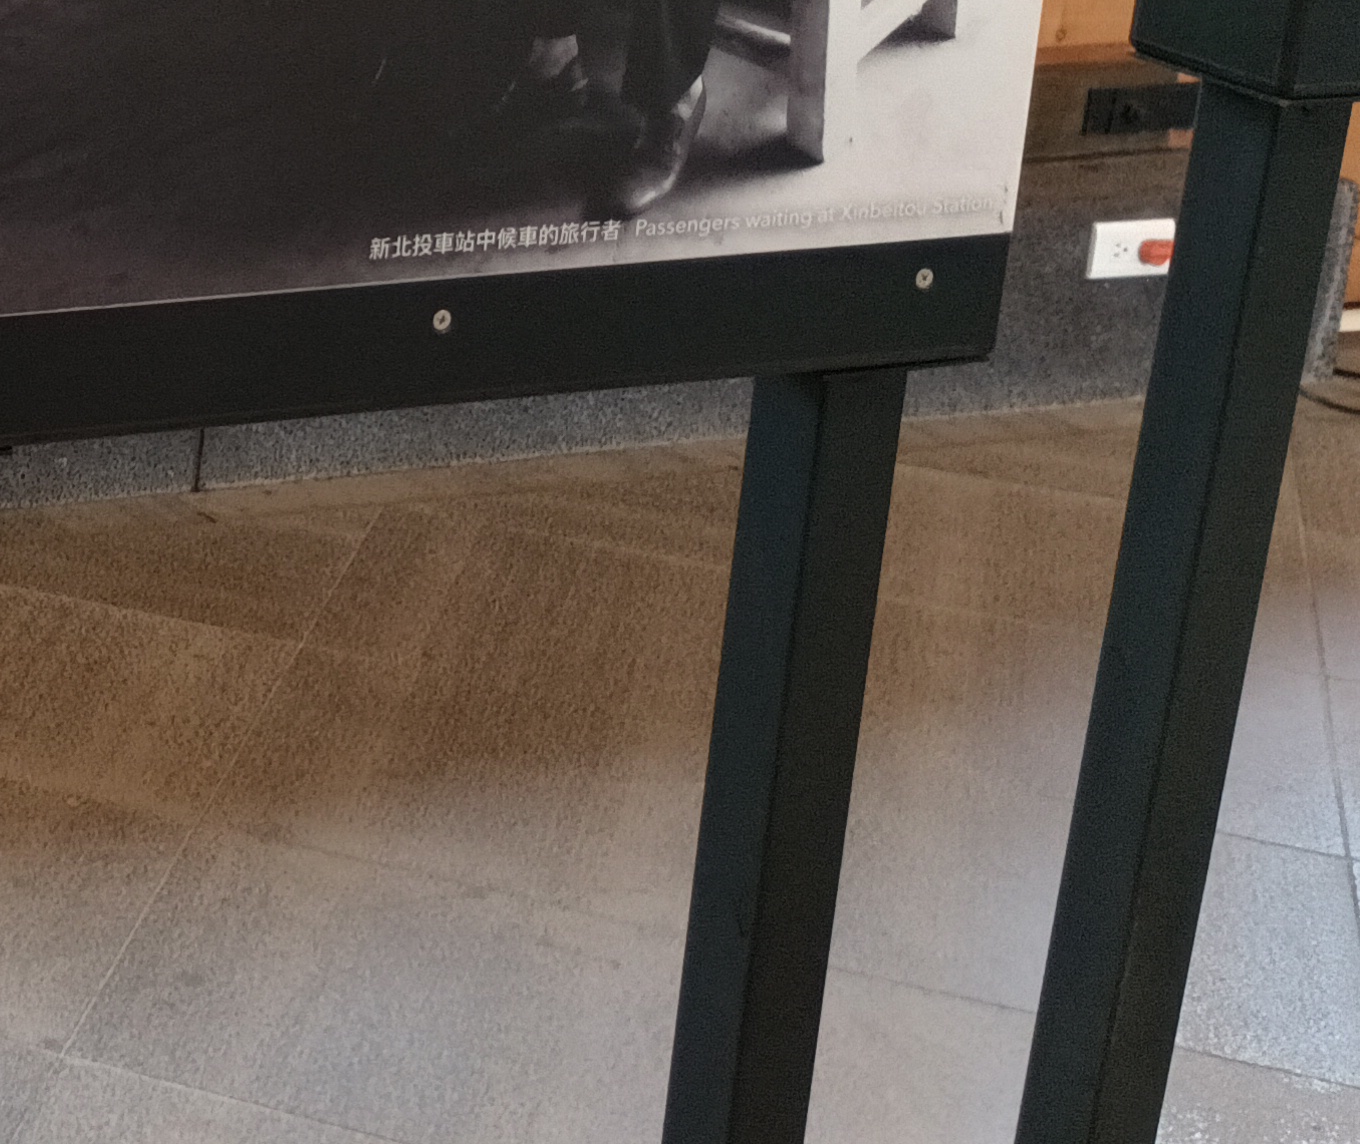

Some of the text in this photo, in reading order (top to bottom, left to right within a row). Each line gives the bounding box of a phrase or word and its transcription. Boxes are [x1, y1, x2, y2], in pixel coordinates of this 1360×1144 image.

[369, 219, 622, 260] 新北投車站中候車的旅行者
[635, 216, 741, 237] Passengers
[745, 210, 813, 229] waiting
